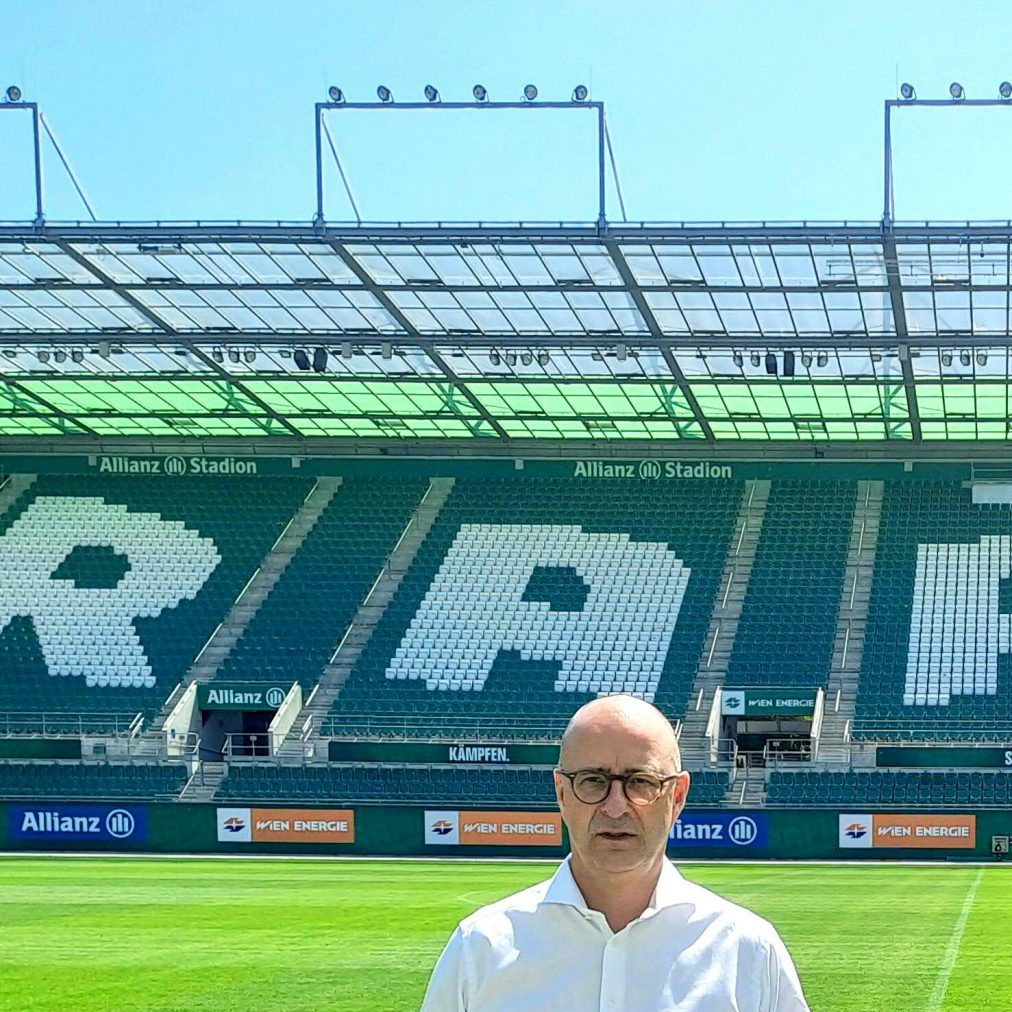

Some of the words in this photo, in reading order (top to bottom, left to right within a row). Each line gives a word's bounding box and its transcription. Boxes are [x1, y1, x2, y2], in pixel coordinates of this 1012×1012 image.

[99, 456, 161, 473] Allianz
[190, 457, 257, 474] Stadion
[574, 461, 635, 477] Allianz
[665, 462, 732, 478] Stadion
[207, 689, 262, 704] Allianz
[748, 699, 773, 707] WIEN
[776, 699, 814, 707] ENERGIE
[449, 744, 510, 761] KÄMPFEN.
[21, 811, 100, 832] Allianz
[256, 820, 290, 831] WIEN
[294, 821, 348, 832] ENERGIE
[464, 824, 497, 834] WIEN
[502, 824, 555, 834] ENERGIE
[877, 826, 911, 837] WIEN
[916, 826, 969, 837] ENERGIE
